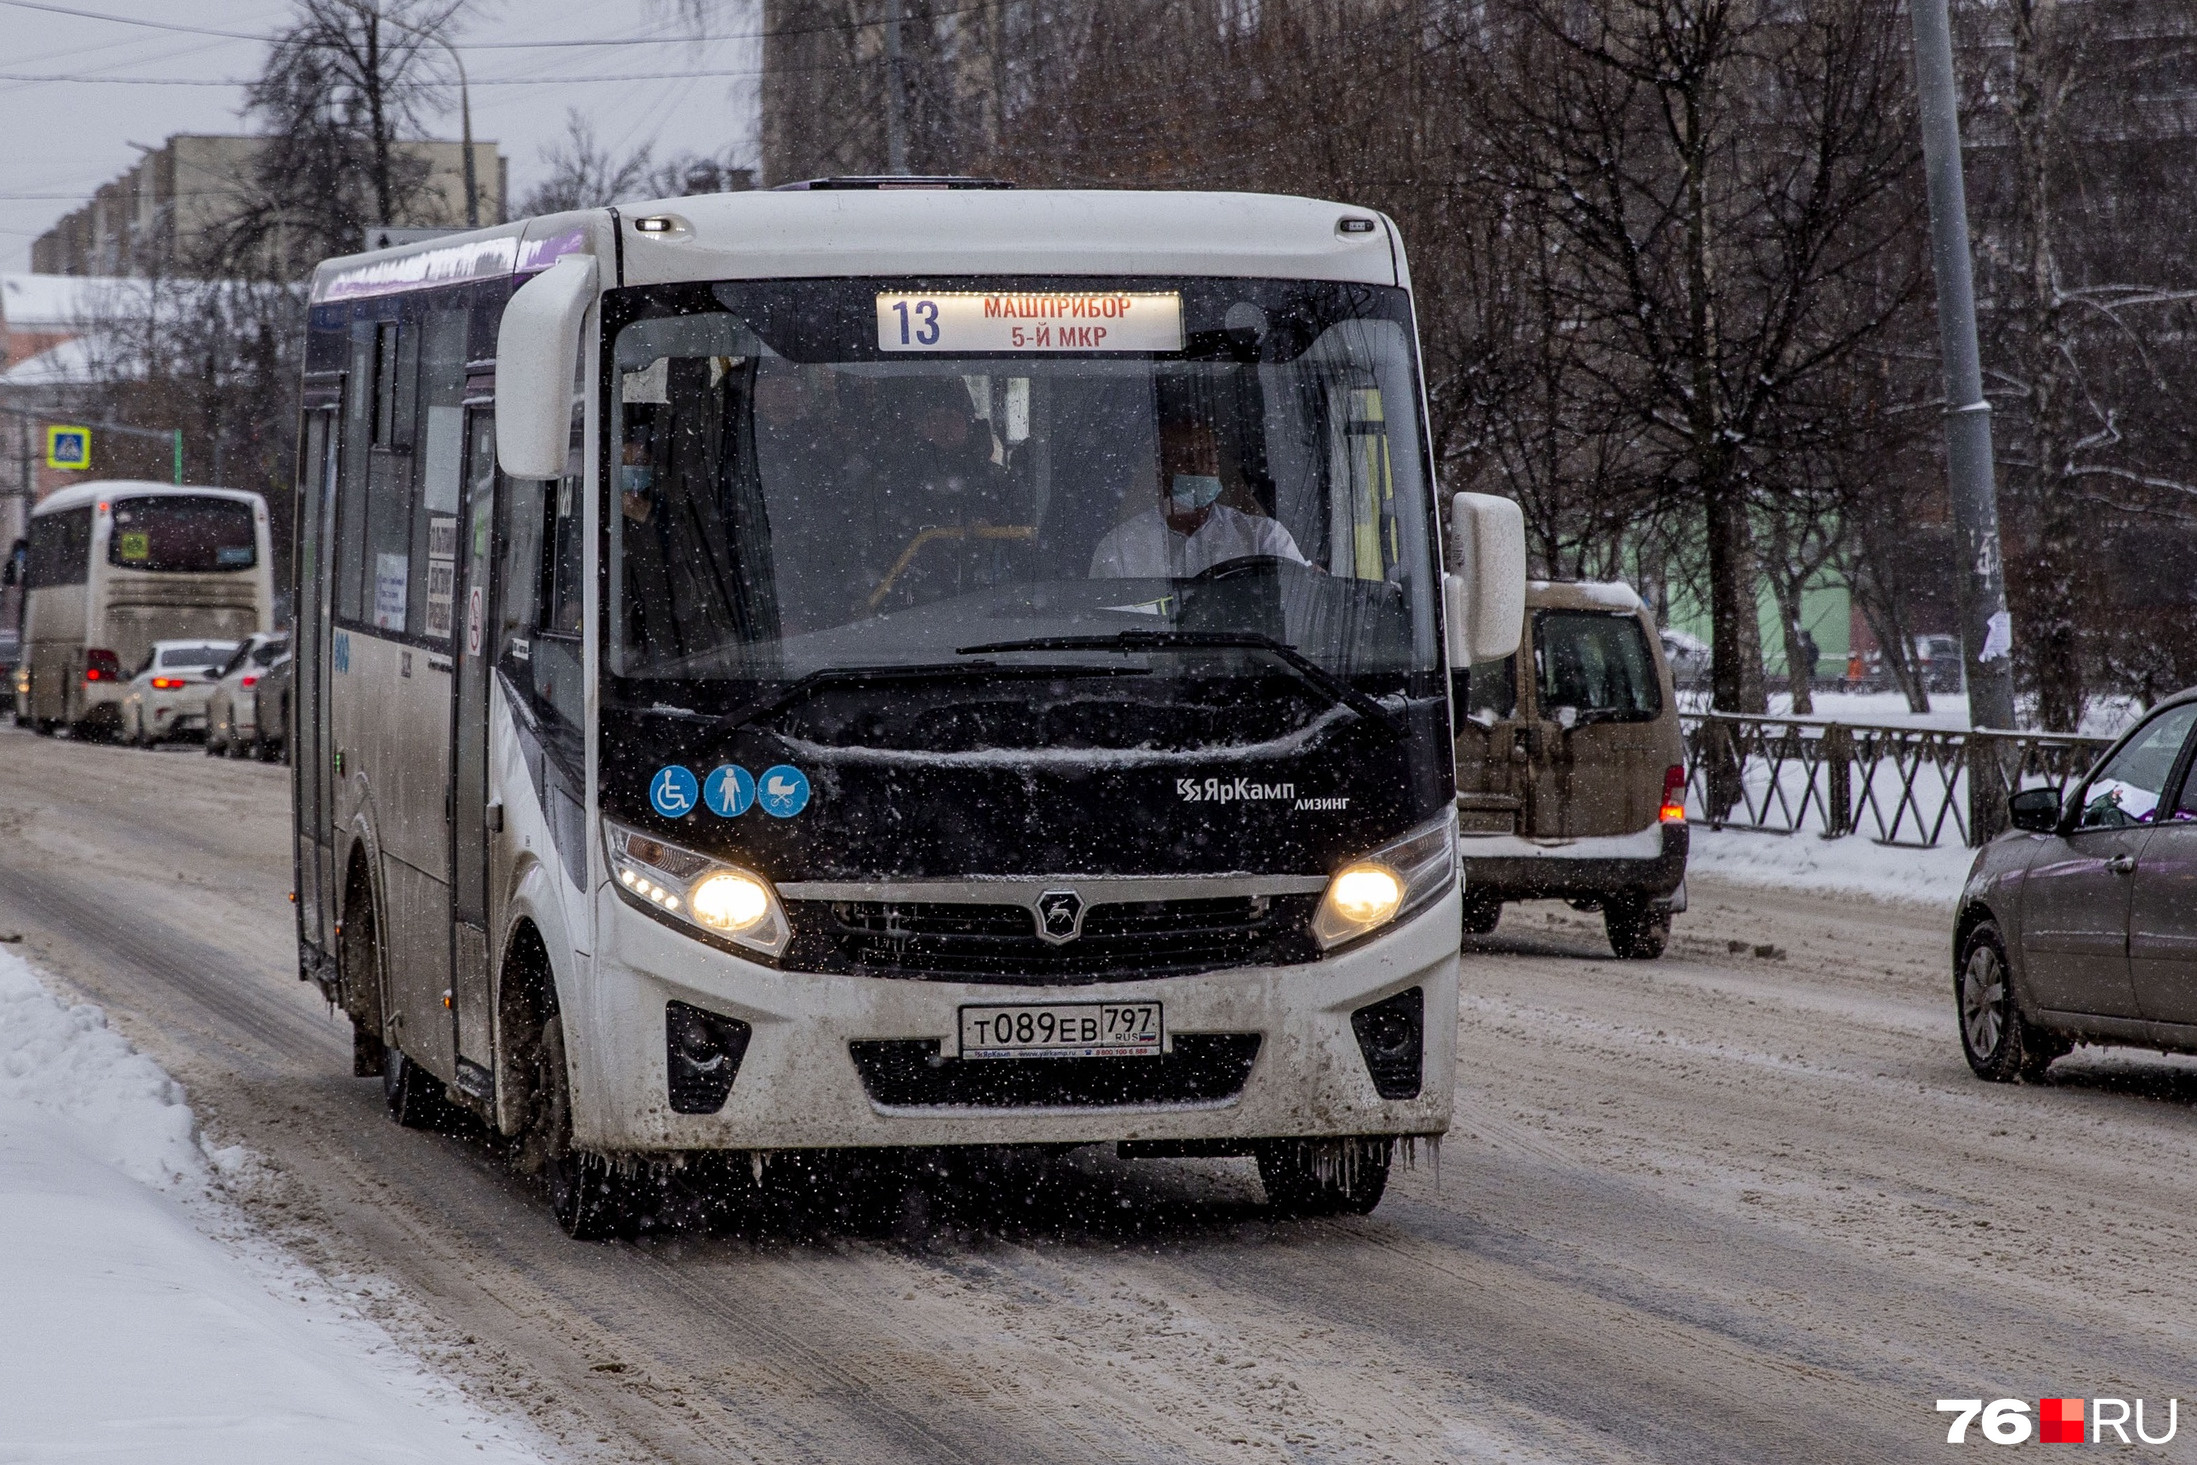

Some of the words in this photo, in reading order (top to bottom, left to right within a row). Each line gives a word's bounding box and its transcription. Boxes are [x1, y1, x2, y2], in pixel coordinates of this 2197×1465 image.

[984, 297, 1131, 318] МАШПРИБОР
[892, 300, 940, 345] 13
[1012, 322, 1051, 347] 5-Й
[1059, 326, 1107, 347] МКР
[1204, 777, 1295, 805] ЯрКамп
[1294, 798, 1350, 810] лизинг
[974, 1012, 1097, 1044] Т089ЕВ
[1104, 1008, 1152, 1033] 797
[1116, 1033, 1139, 1042] RUS
